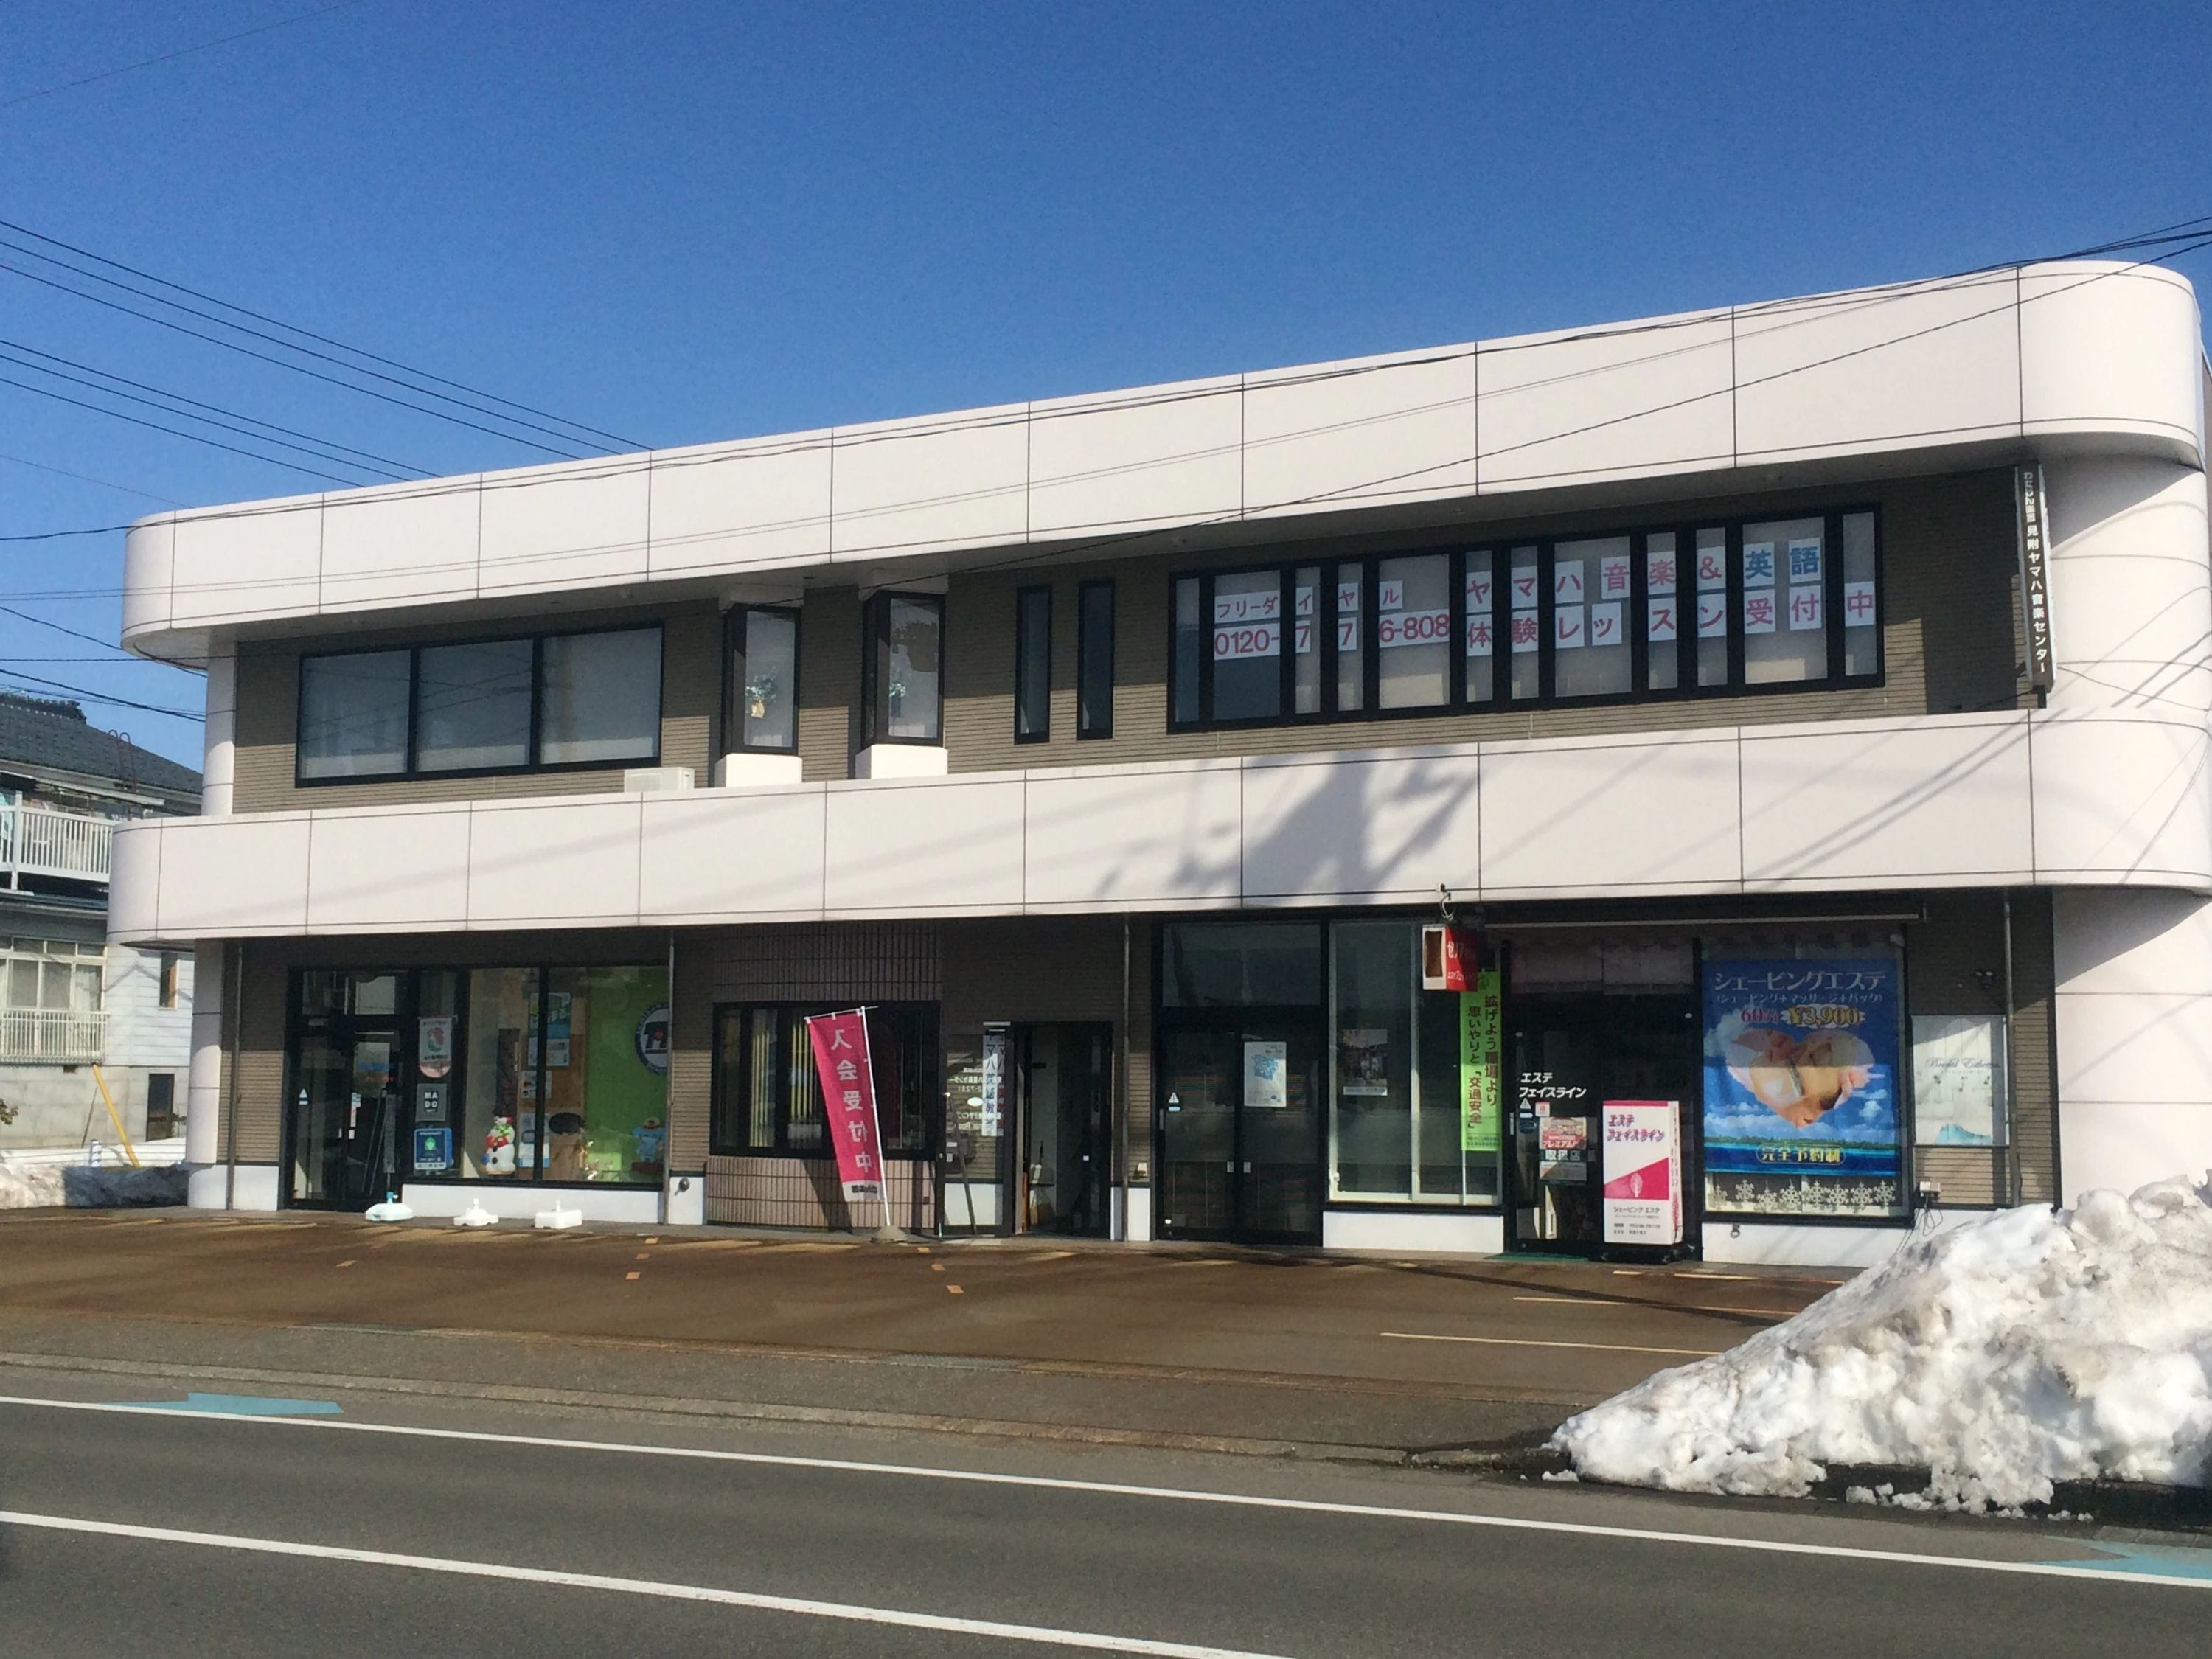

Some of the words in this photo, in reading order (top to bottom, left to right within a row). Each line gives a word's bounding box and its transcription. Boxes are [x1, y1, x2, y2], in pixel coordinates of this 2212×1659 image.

[1714, 971, 1886, 991] シェービングエステ
[1788, 1006, 1861, 1026] ¥3,900
[1520, 1072, 1553, 1083] エステ
[1519, 1087, 1587, 1098] フェイスライン
[1608, 1114, 1635, 1127] エステ
[1607, 1129, 1665, 1142] フェイスライン
[1761, 1145, 1840, 1163] 完全予約制
